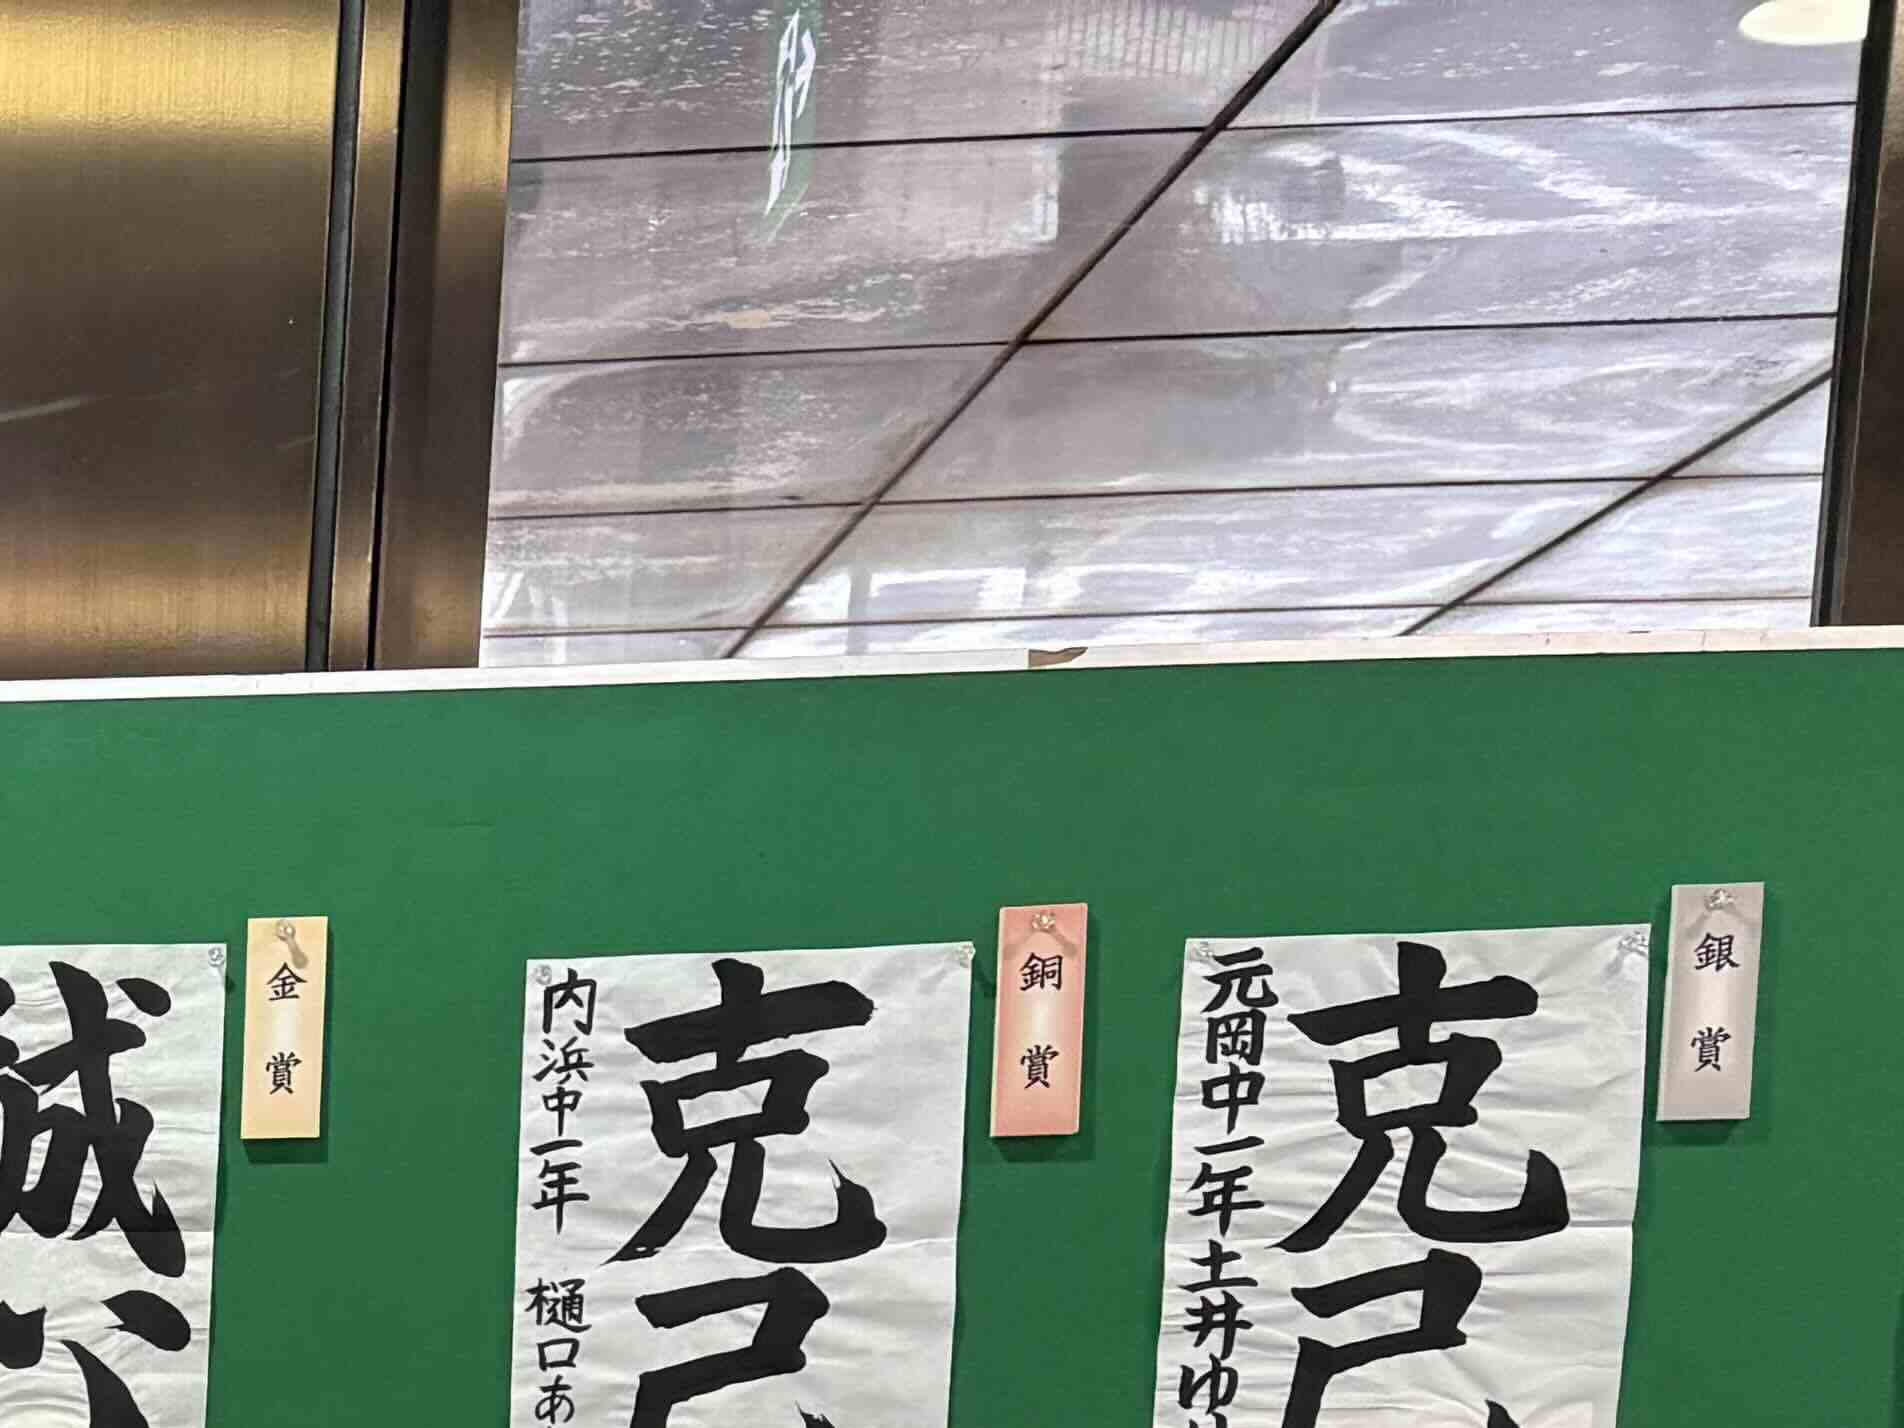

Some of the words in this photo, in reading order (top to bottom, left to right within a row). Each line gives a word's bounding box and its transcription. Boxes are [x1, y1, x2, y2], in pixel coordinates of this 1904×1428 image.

[265, 962, 308, 1095] 金賞
[1019, 952, 1062, 1090] 銅賞
[1690, 932, 1739, 1073] 銀賞
